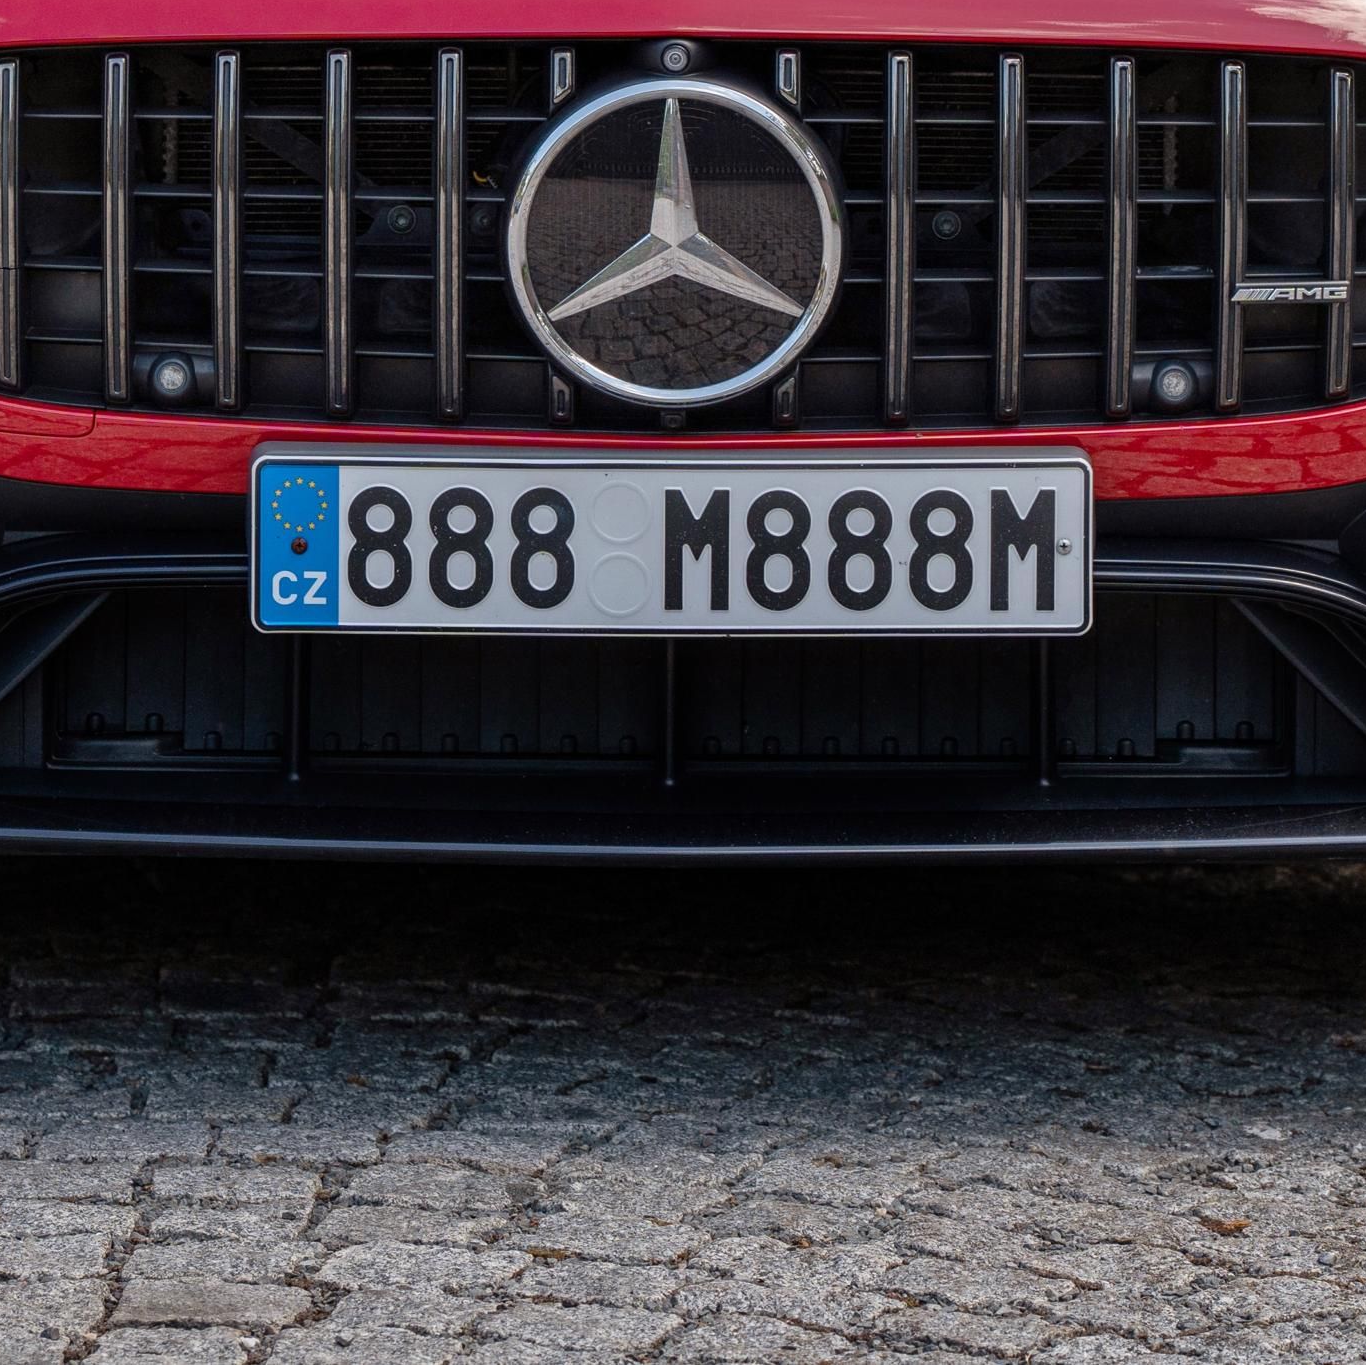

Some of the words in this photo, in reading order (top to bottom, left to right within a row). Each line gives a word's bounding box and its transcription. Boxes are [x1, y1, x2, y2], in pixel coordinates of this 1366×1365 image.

[1268, 287, 1347, 300] AMG
[347, 486, 576, 610] 888
[664, 487, 1056, 612] M888M
[272, 570, 327, 605] CZ
